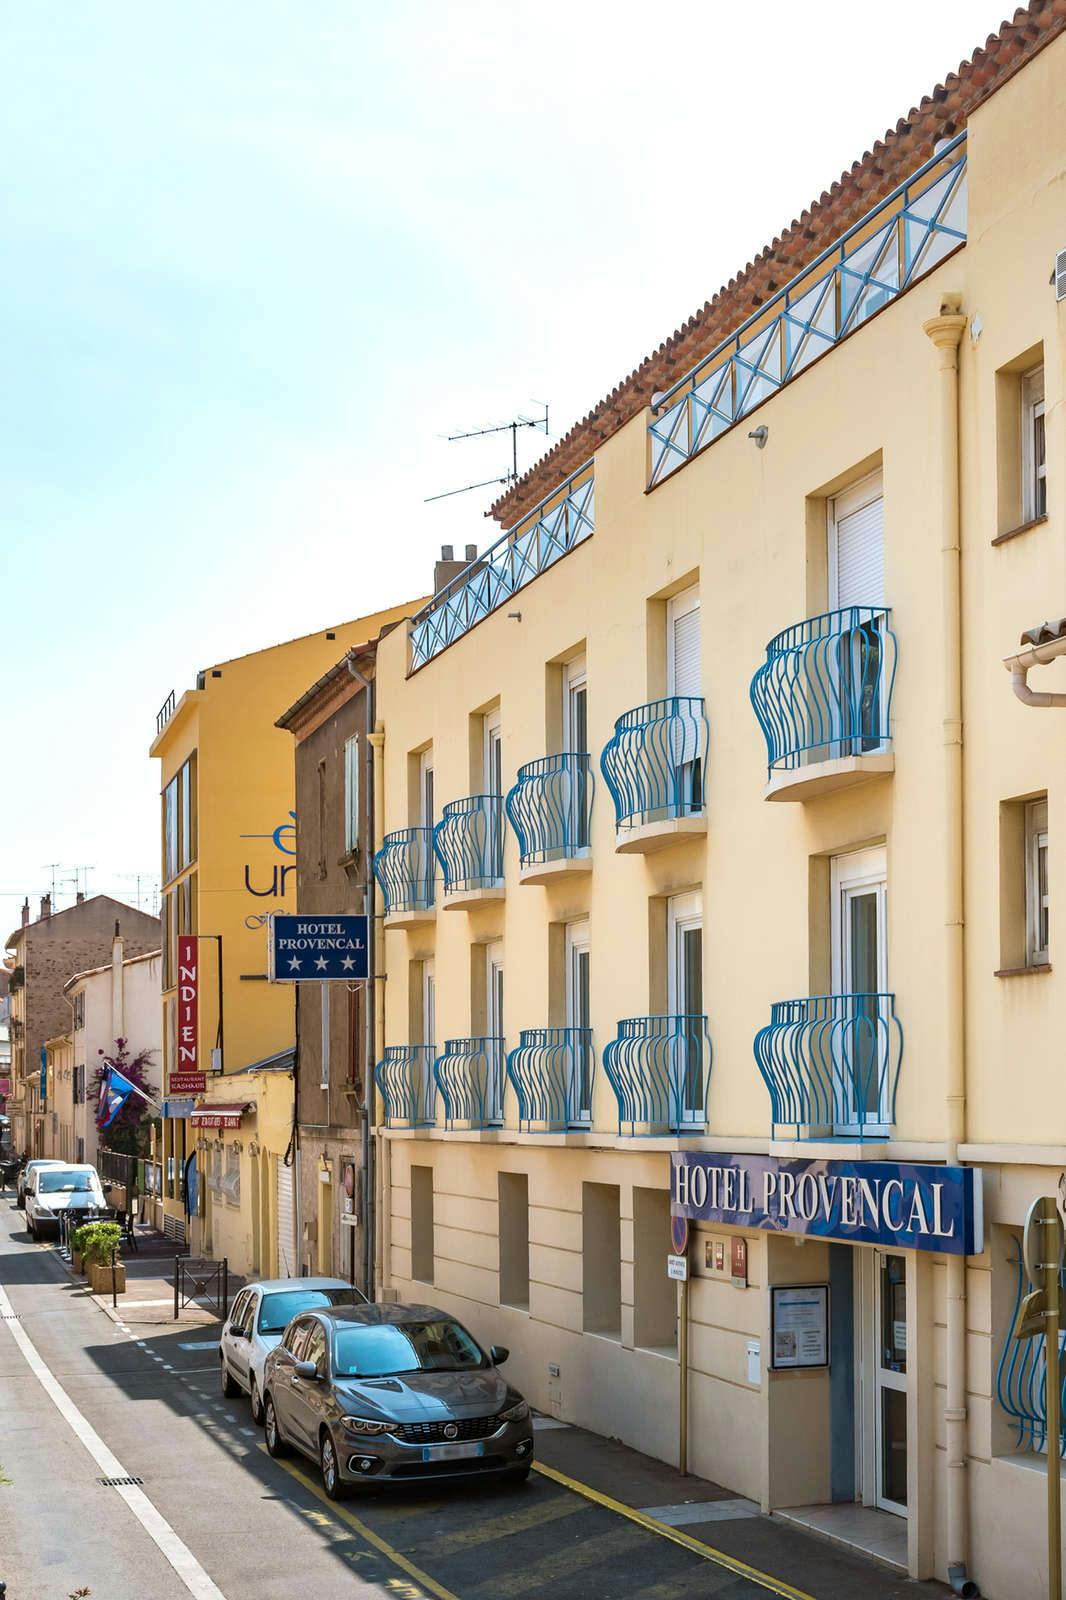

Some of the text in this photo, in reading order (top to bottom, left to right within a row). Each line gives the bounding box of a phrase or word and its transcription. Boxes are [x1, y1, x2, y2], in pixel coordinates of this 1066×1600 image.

[297, 923, 346, 935] HOTEL
[279, 938, 365, 950] PROVENCAL
[179, 946, 197, 1062] INDIEN
[674, 1164, 954, 1237] HOTEL PROVENCAL
[737, 1245, 744, 1260] H
